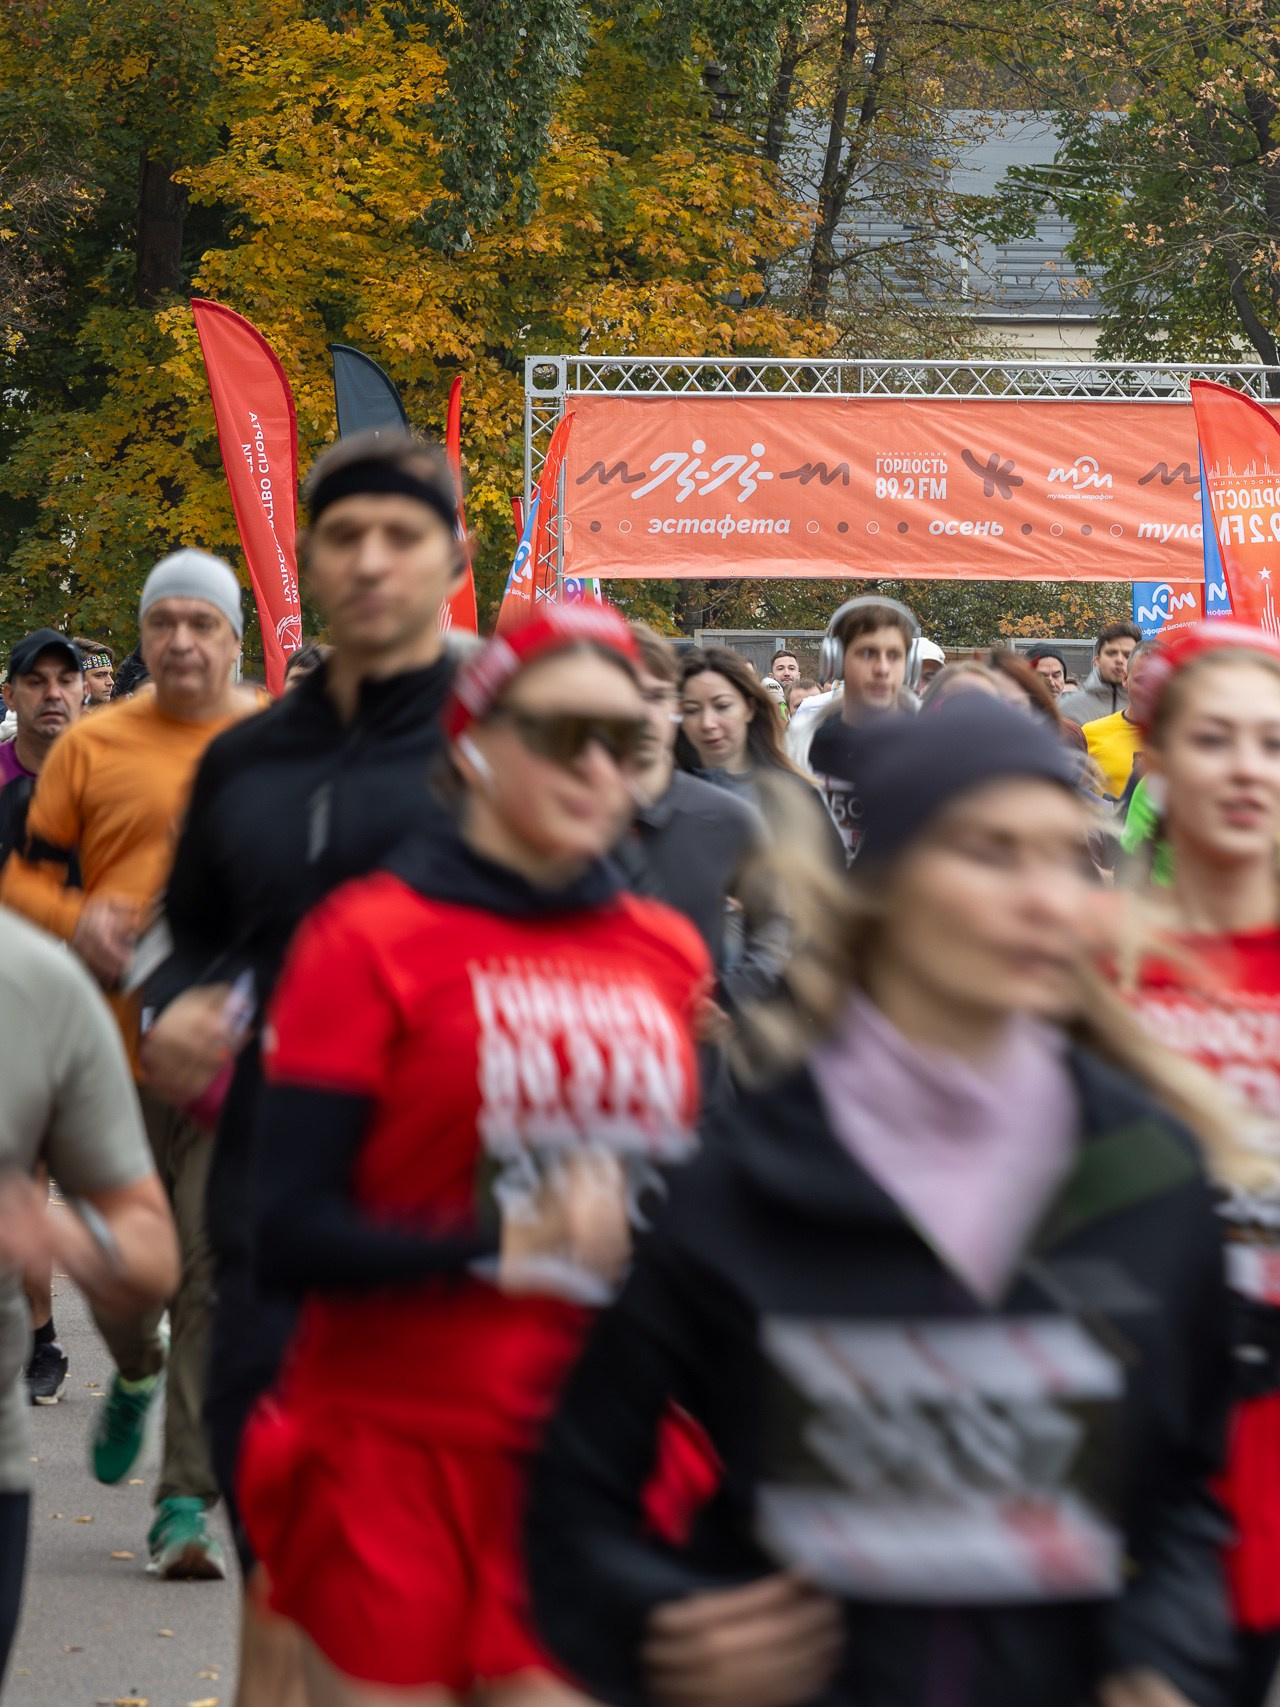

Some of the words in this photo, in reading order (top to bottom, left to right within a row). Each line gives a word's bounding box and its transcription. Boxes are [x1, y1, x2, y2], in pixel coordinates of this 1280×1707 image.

[876, 458, 948, 474] ГОРДОСТЬ
[875, 477, 915, 500] 89.2
[918, 477, 947, 500] FM
[1046, 493, 1080, 501] тульский
[647, 513, 791, 539] эстафета
[929, 519, 1004, 537] осень
